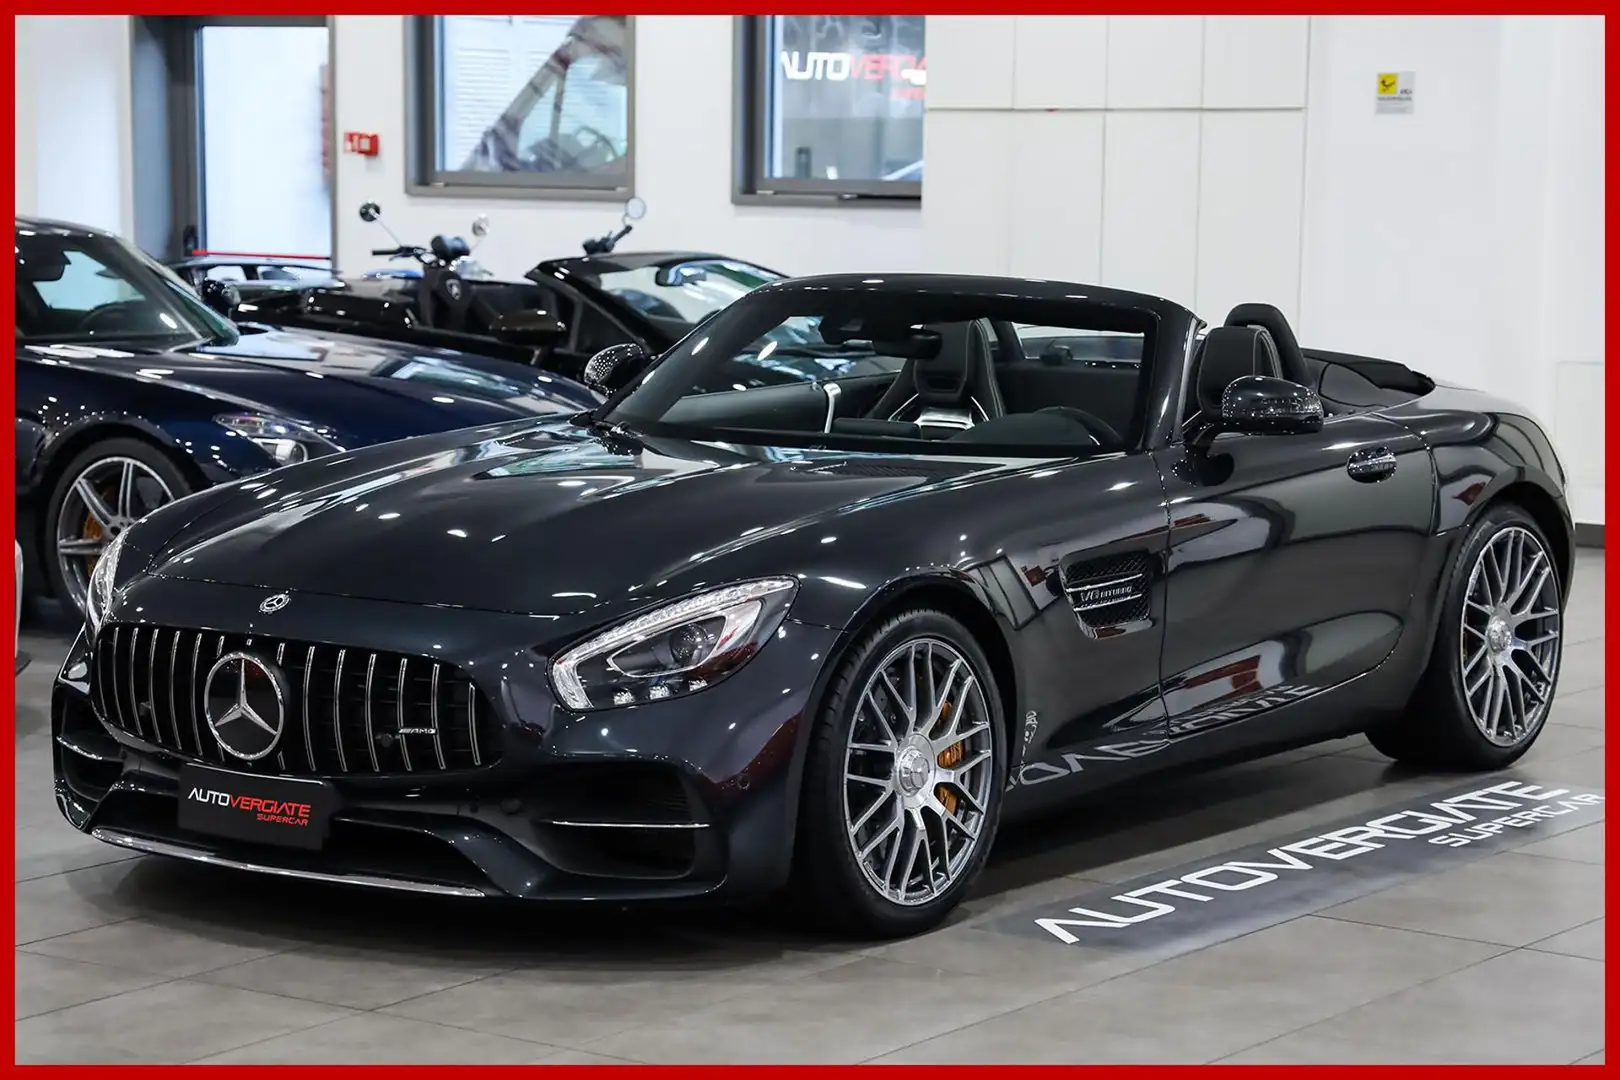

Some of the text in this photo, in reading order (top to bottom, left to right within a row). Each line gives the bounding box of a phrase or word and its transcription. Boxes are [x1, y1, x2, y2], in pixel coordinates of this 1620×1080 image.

[187, 787, 312, 818] AUTOVERGIATE
[256, 812, 309, 827] SUPERCAR
[1428, 793, 1605, 848] SUPERCAR
[1034, 780, 1570, 945] AUTOVERGIATE
